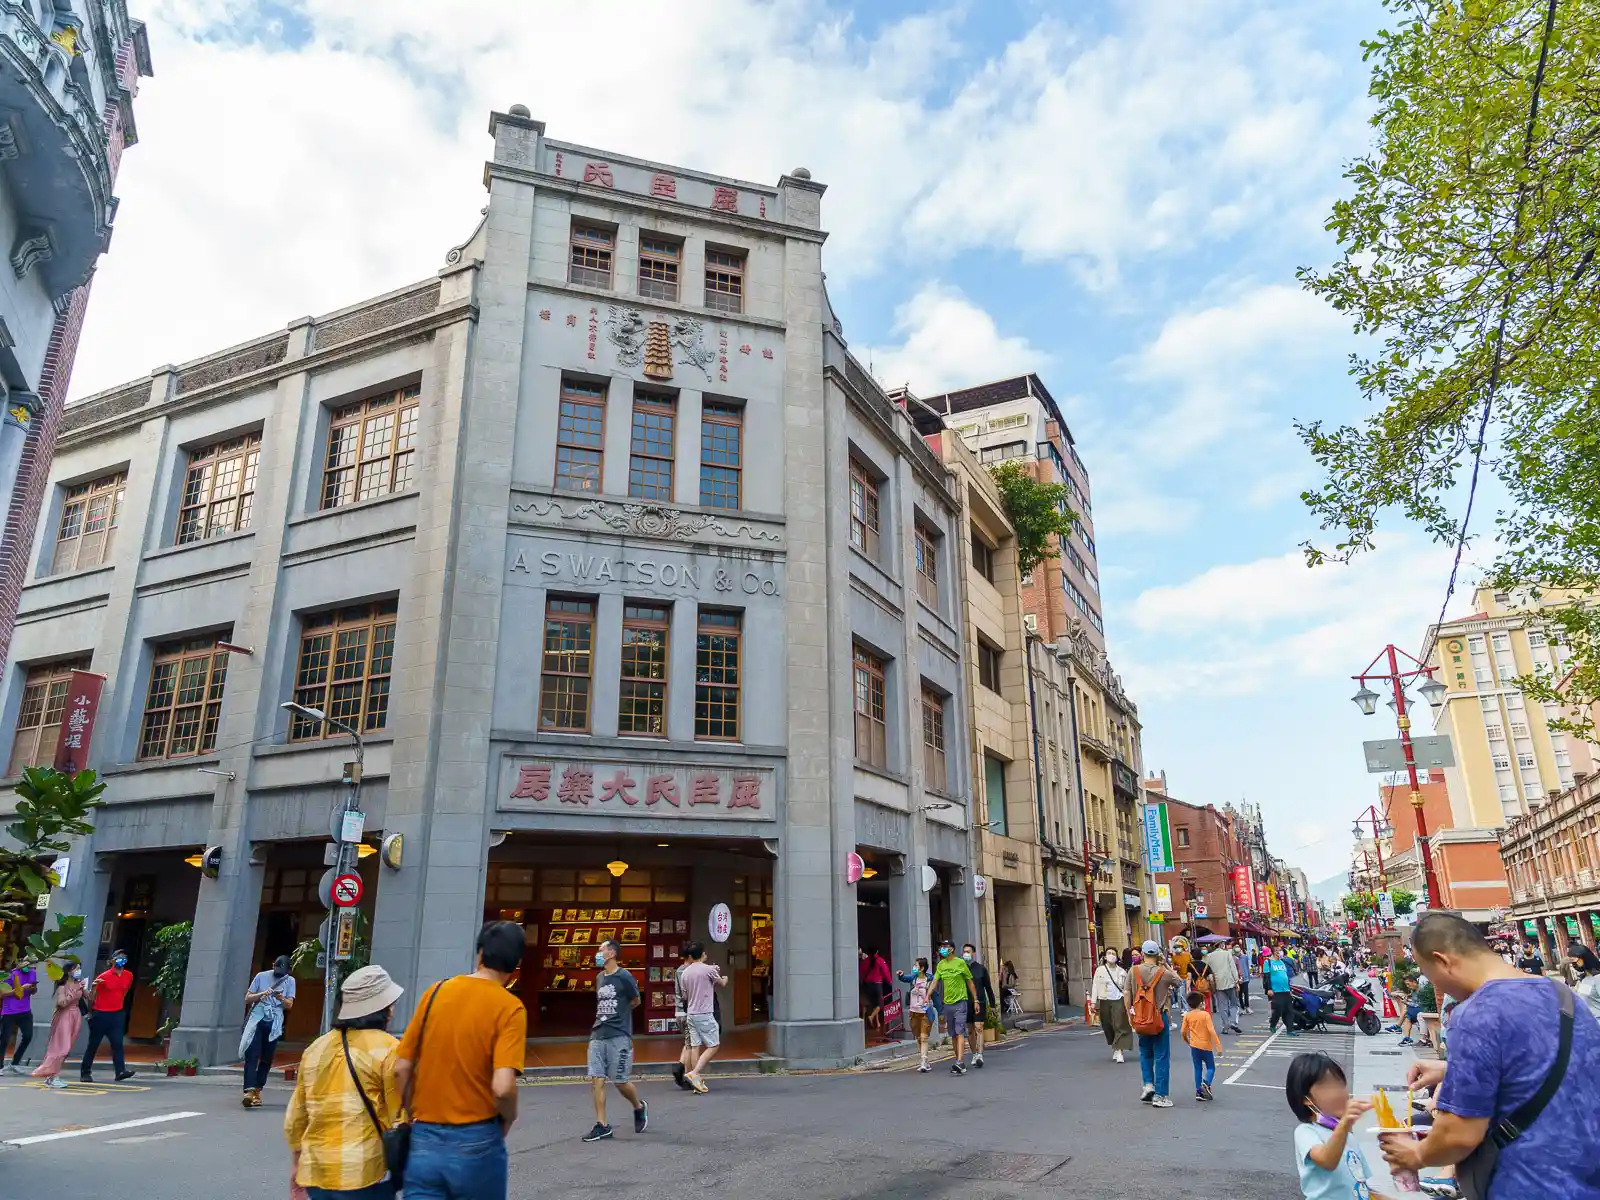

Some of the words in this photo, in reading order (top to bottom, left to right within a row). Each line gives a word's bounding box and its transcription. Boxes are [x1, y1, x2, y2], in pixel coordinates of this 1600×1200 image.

[713, 568, 733, 592] &
[510, 763, 762, 810] 屈臣氏大藥房
[1148, 809, 1160, 860] FamilyMart
